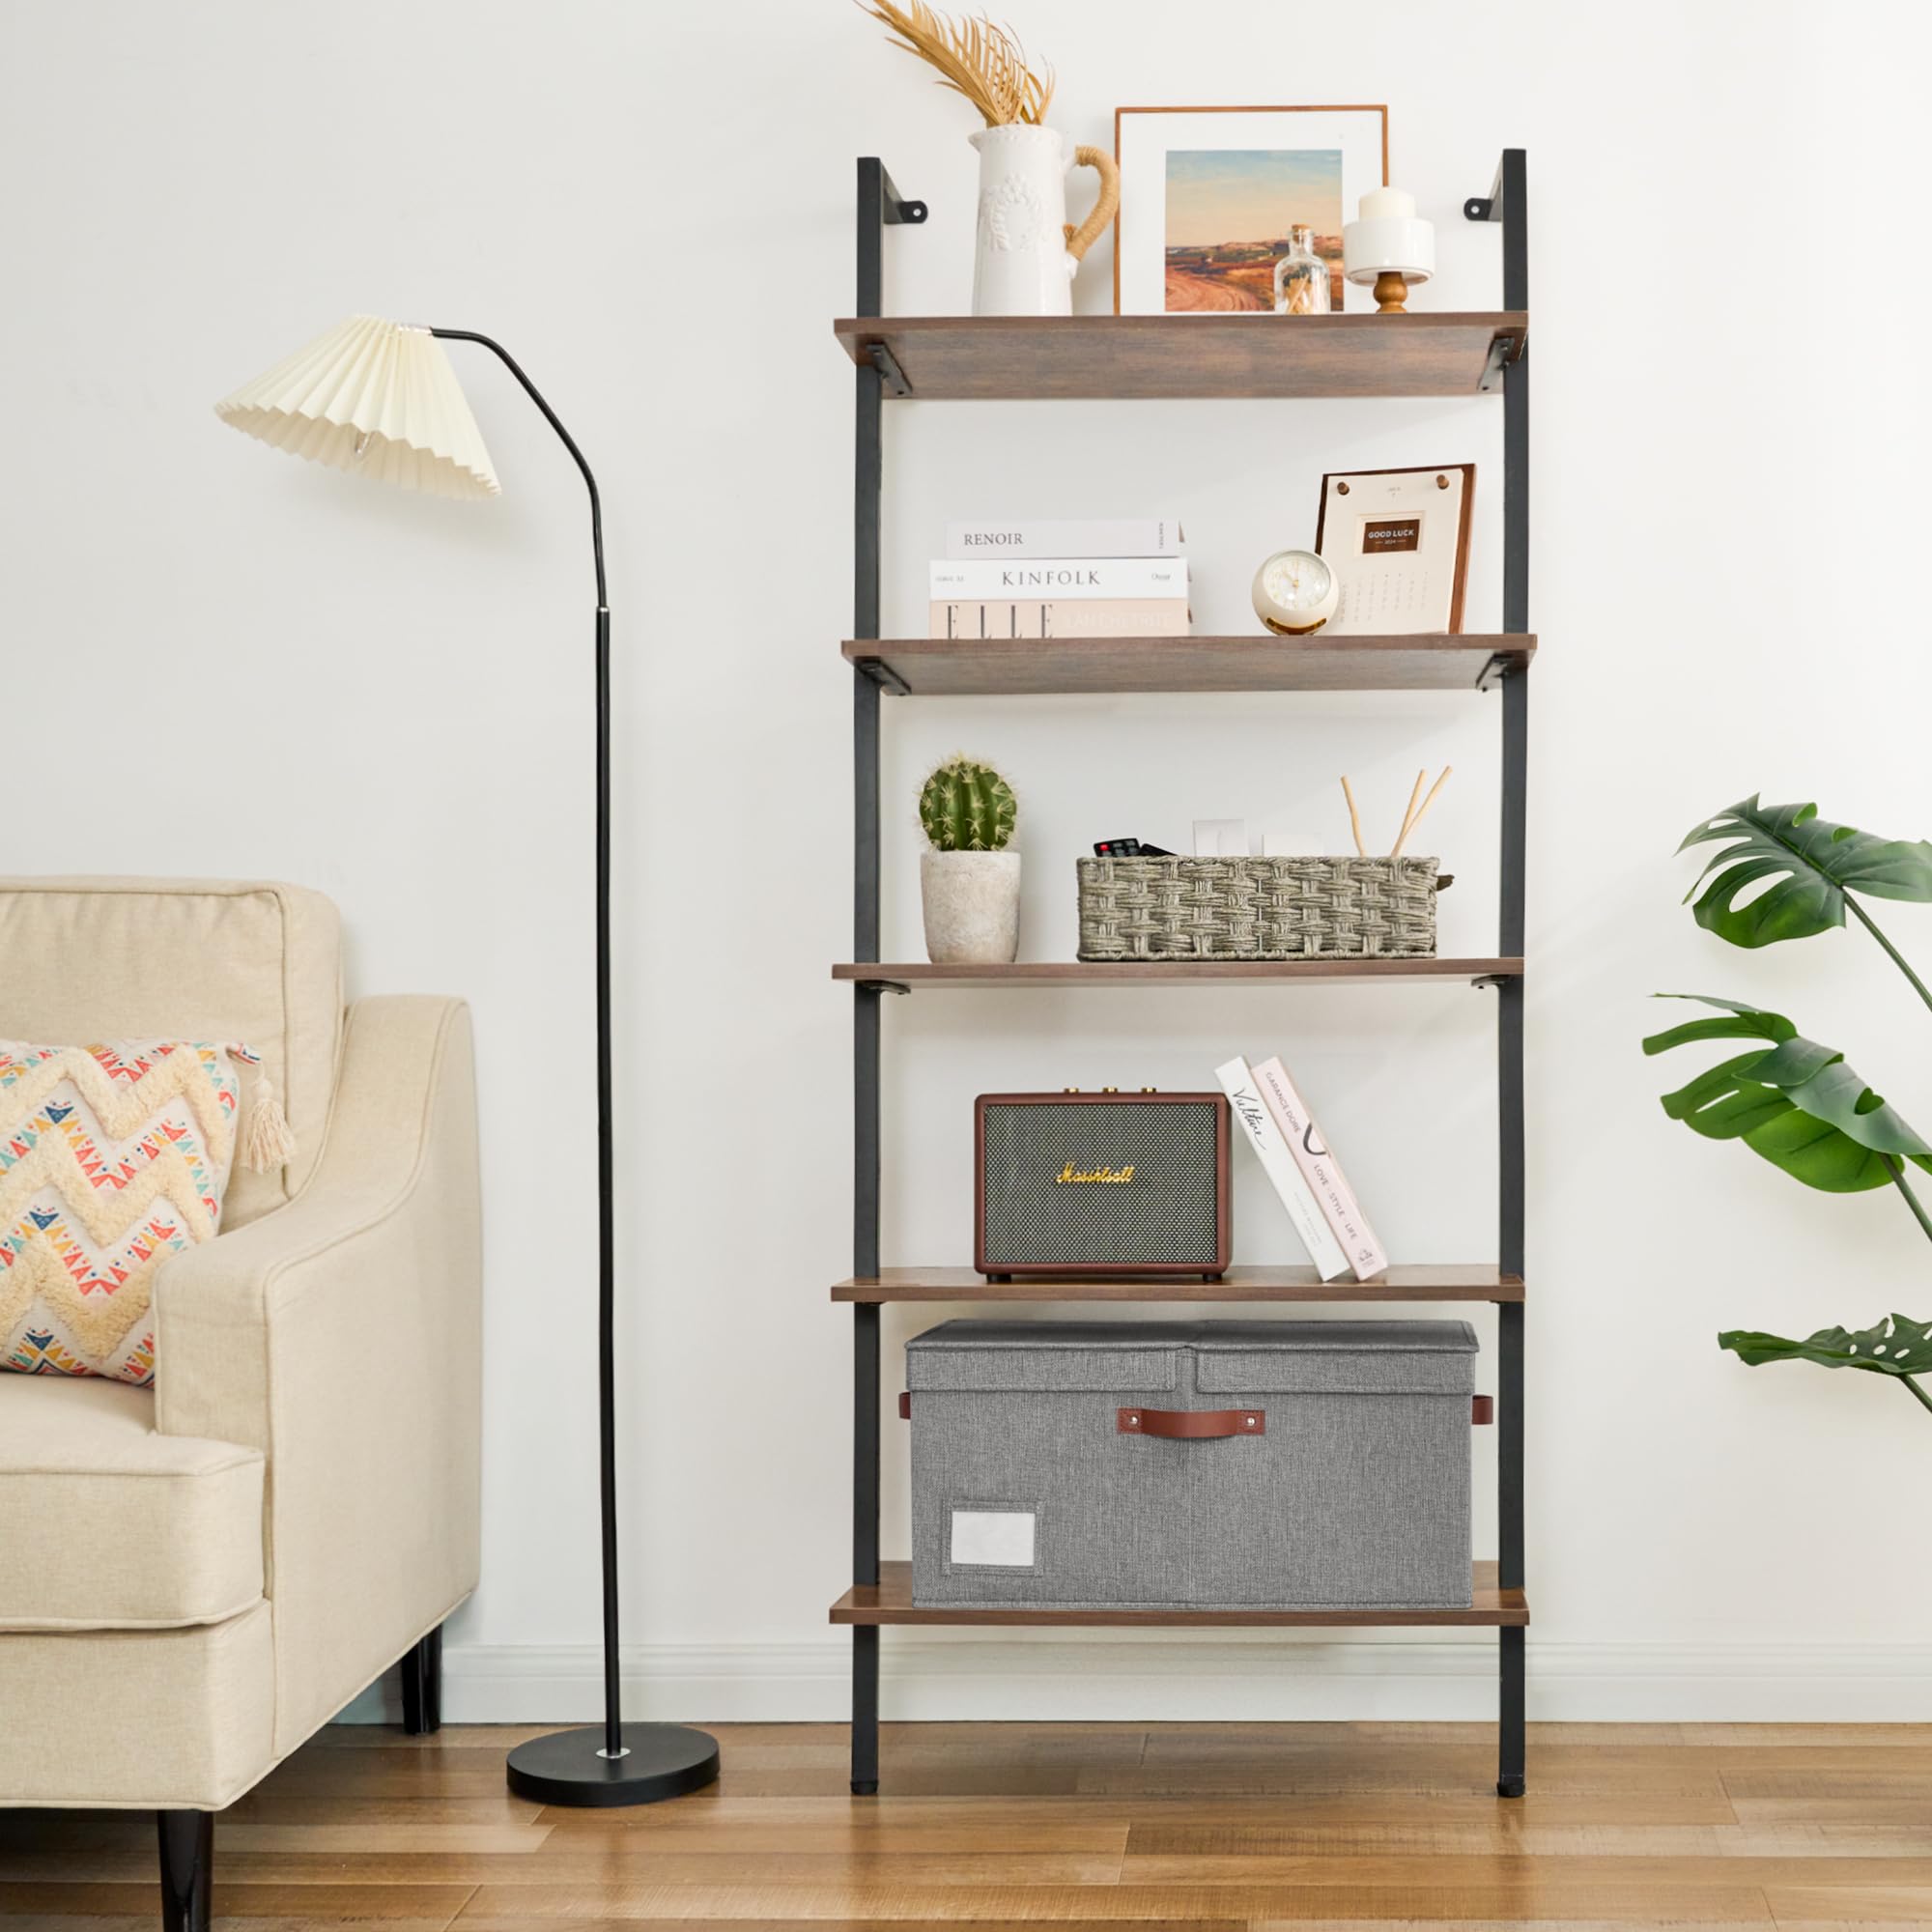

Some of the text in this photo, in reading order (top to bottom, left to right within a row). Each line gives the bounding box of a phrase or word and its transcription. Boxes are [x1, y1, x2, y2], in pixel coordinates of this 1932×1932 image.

[964, 532, 1024, 546] RENOIR
[1368, 528, 1415, 539] GOOD LUCK
[1002, 570, 1100, 586] KINFOLK
[1265, 1072, 1290, 1110] GARANCE
[1232, 1088, 1267, 1151] Vulture
[1056, 1160, 1135, 1184] Marshall
[1313, 1164, 1358, 1240] LOVE STYLE LIFE
